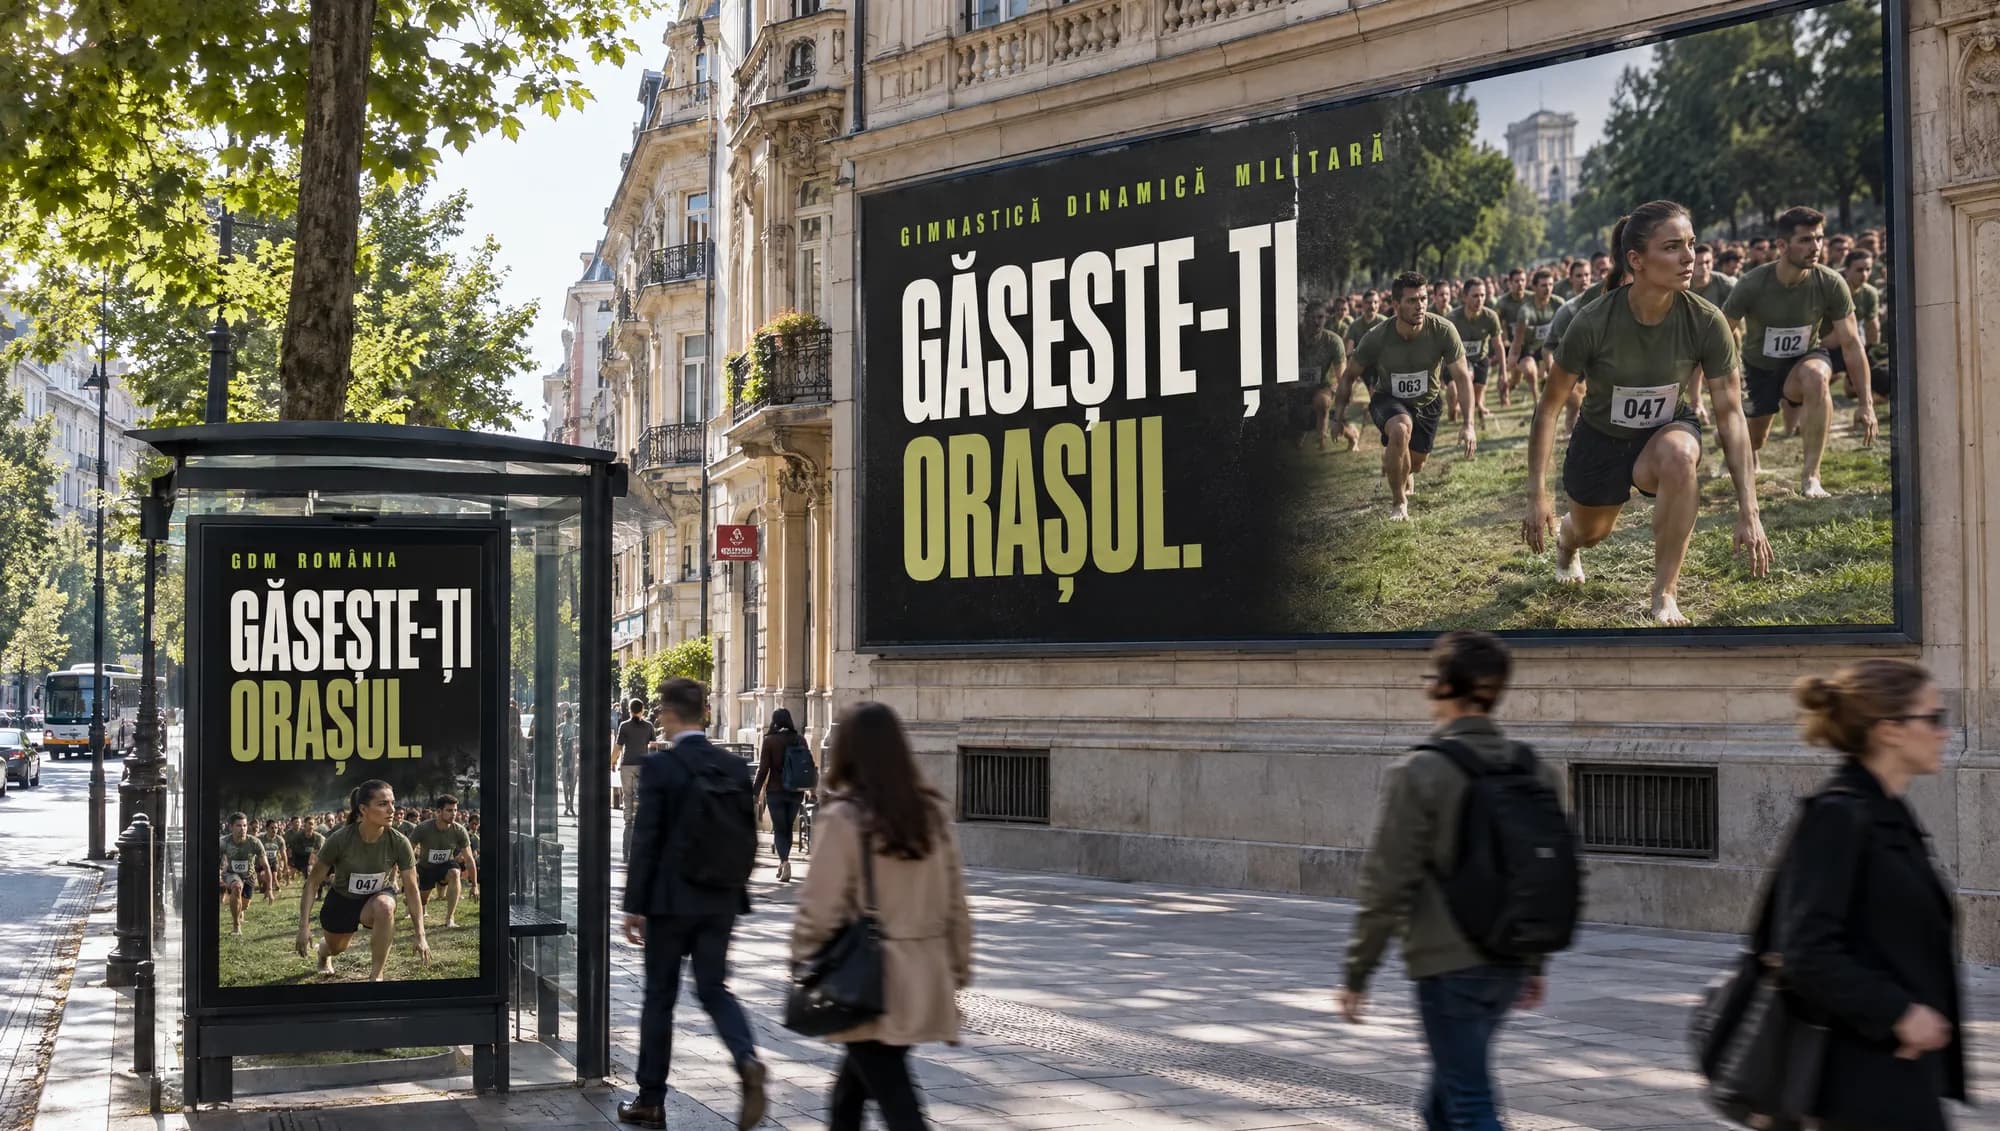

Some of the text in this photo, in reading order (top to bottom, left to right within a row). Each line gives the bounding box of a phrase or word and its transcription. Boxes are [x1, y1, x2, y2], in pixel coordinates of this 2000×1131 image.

[900, 132, 1384, 247] GIMNASTICĂ DINAMICĂ MILITARĂ
[902, 219, 1300, 432] GĂSEȘTE-ȚI
[1773, 335, 1802, 352] 102
[1398, 379, 1421, 393] 063
[1623, 396, 1667, 419] 047
[903, 415, 1203, 603] ORAȘUL.
[231, 549, 397, 569] GDM ROMÂNIA
[230, 578, 472, 684] GĂSEȘTE-ȚI
[230, 678, 423, 776] ORAȘUL.
[355, 879, 379, 891] 047
